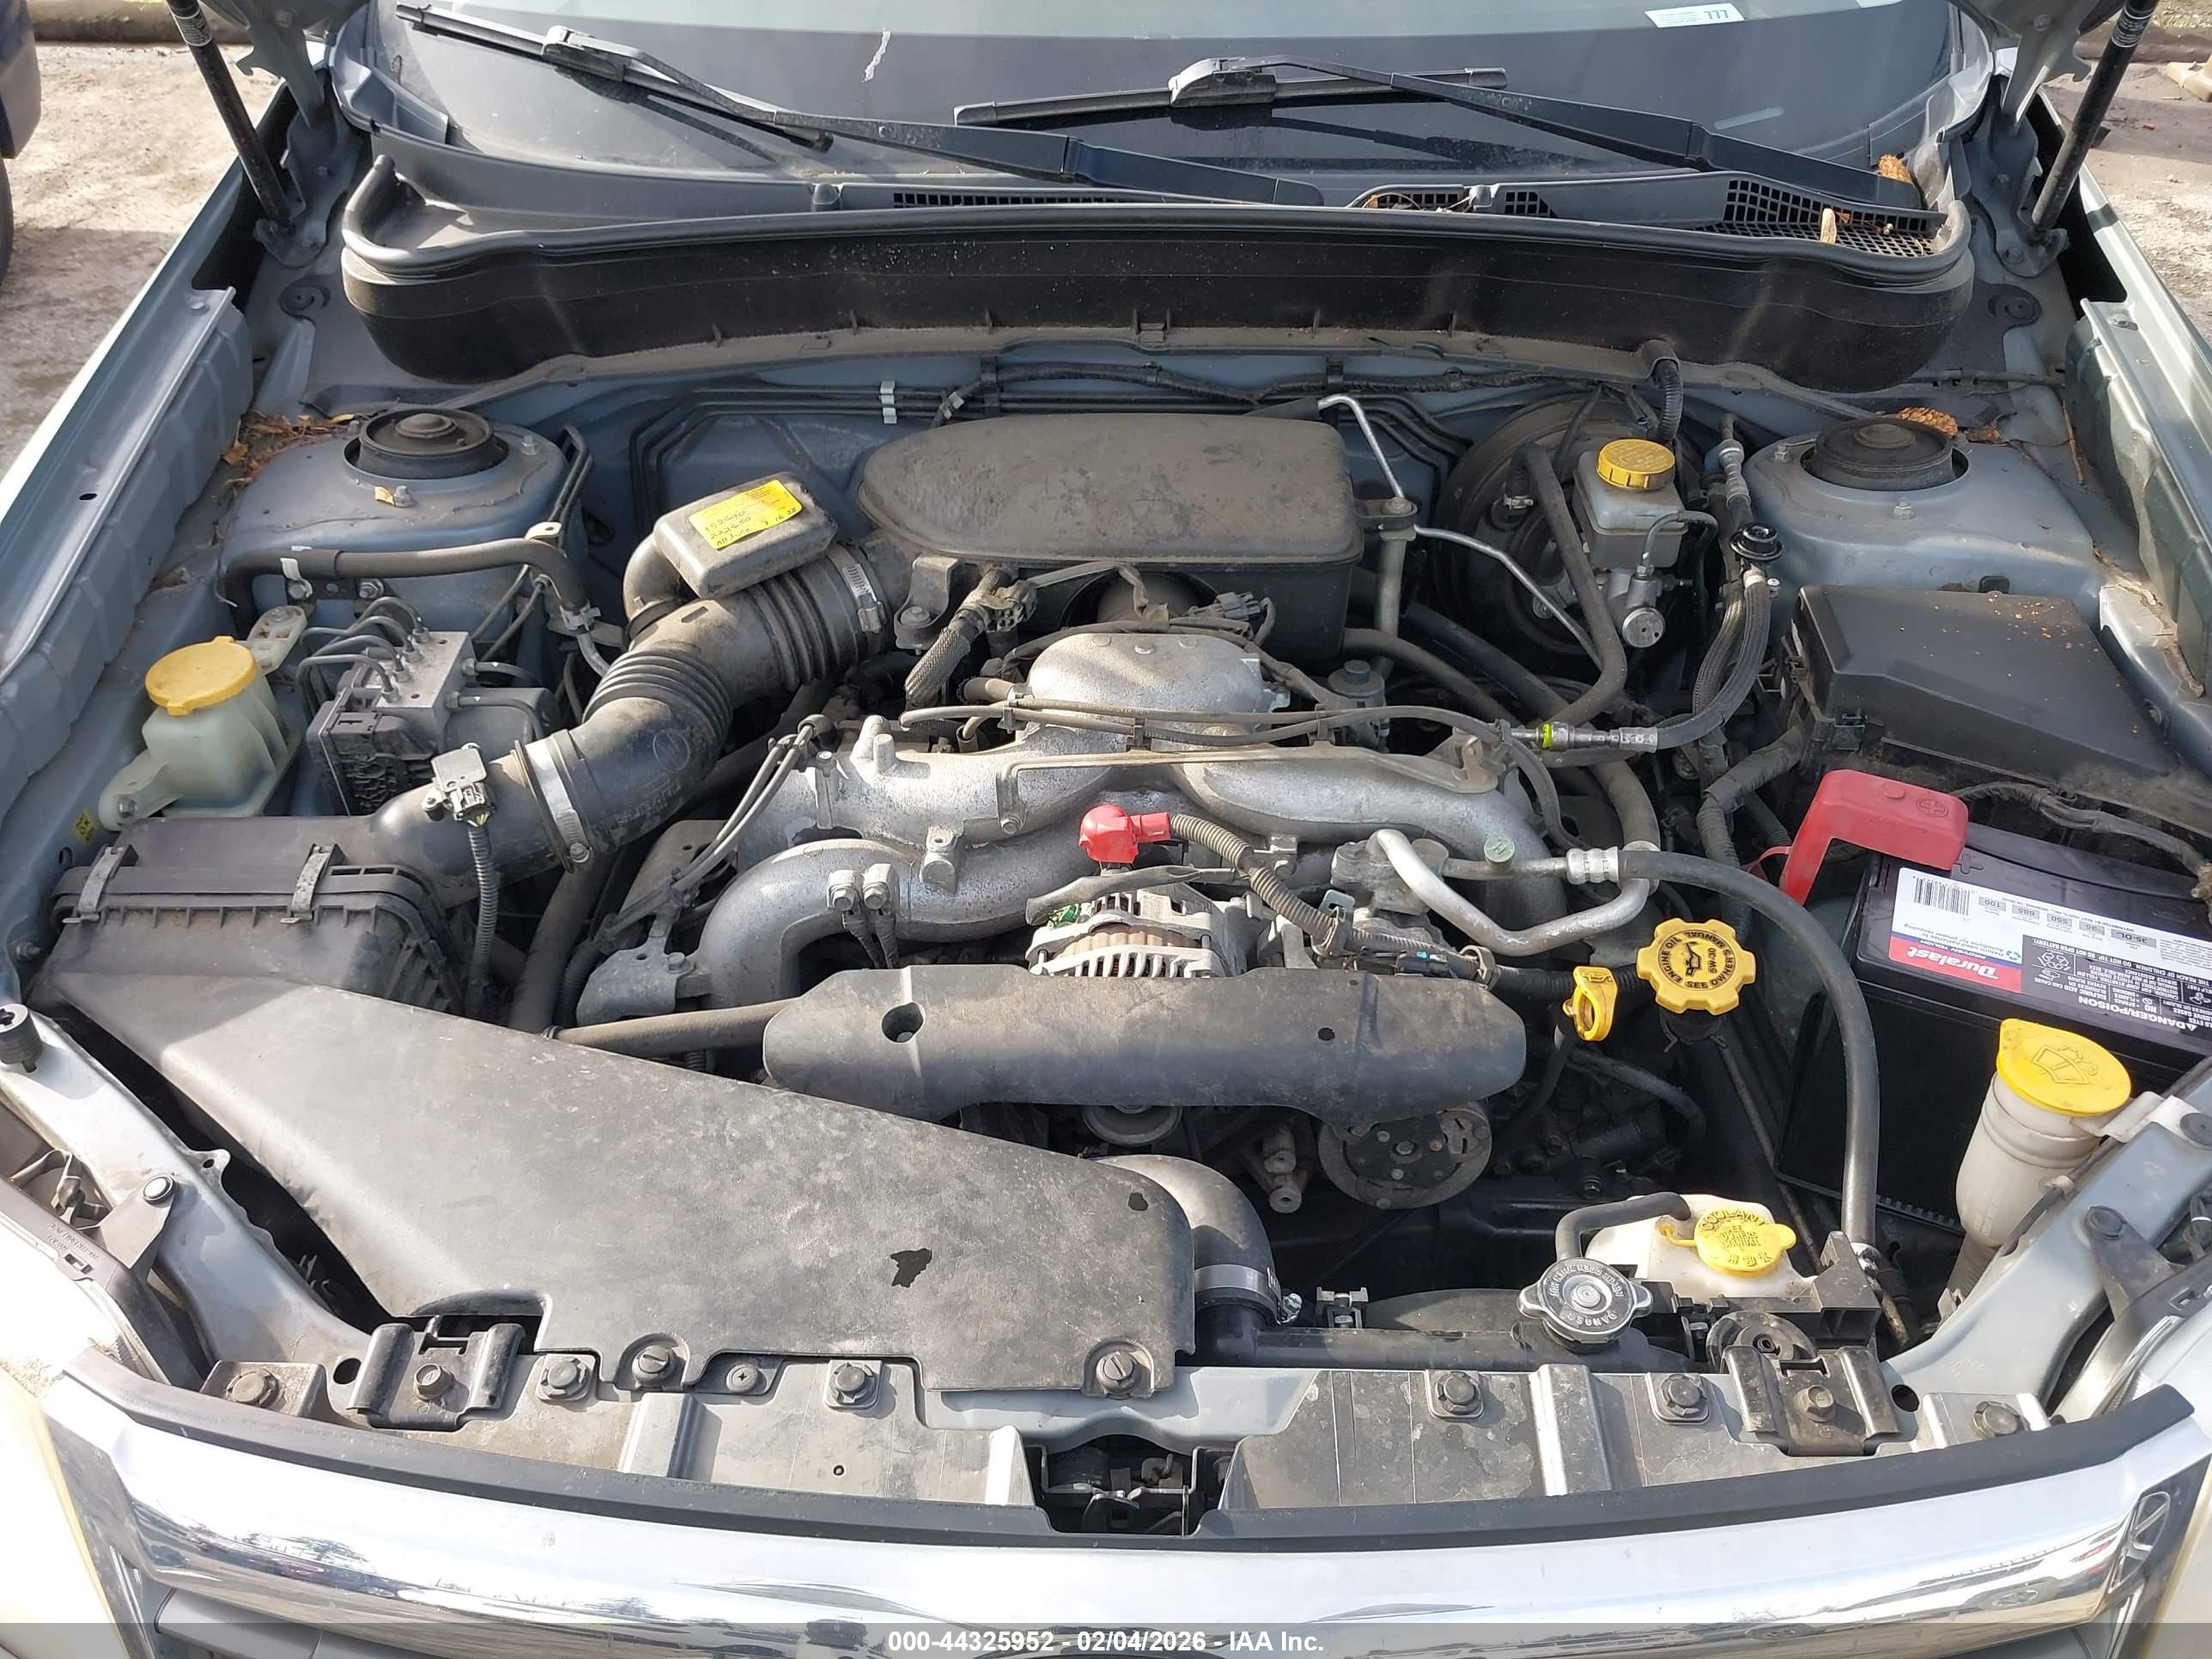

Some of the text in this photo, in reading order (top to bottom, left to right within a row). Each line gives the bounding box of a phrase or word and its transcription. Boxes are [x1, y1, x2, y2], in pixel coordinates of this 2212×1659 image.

[1703, 9, 1729, 19] 777
[1684, 932, 1725, 948] MANUAL
[1661, 937, 1683, 982] ENGINE OIL
[1906, 946, 1998, 980] Duralast
[2078, 995, 2186, 1030] DANGER/POISON
[1567, 1310, 1618, 1328] DANGER
